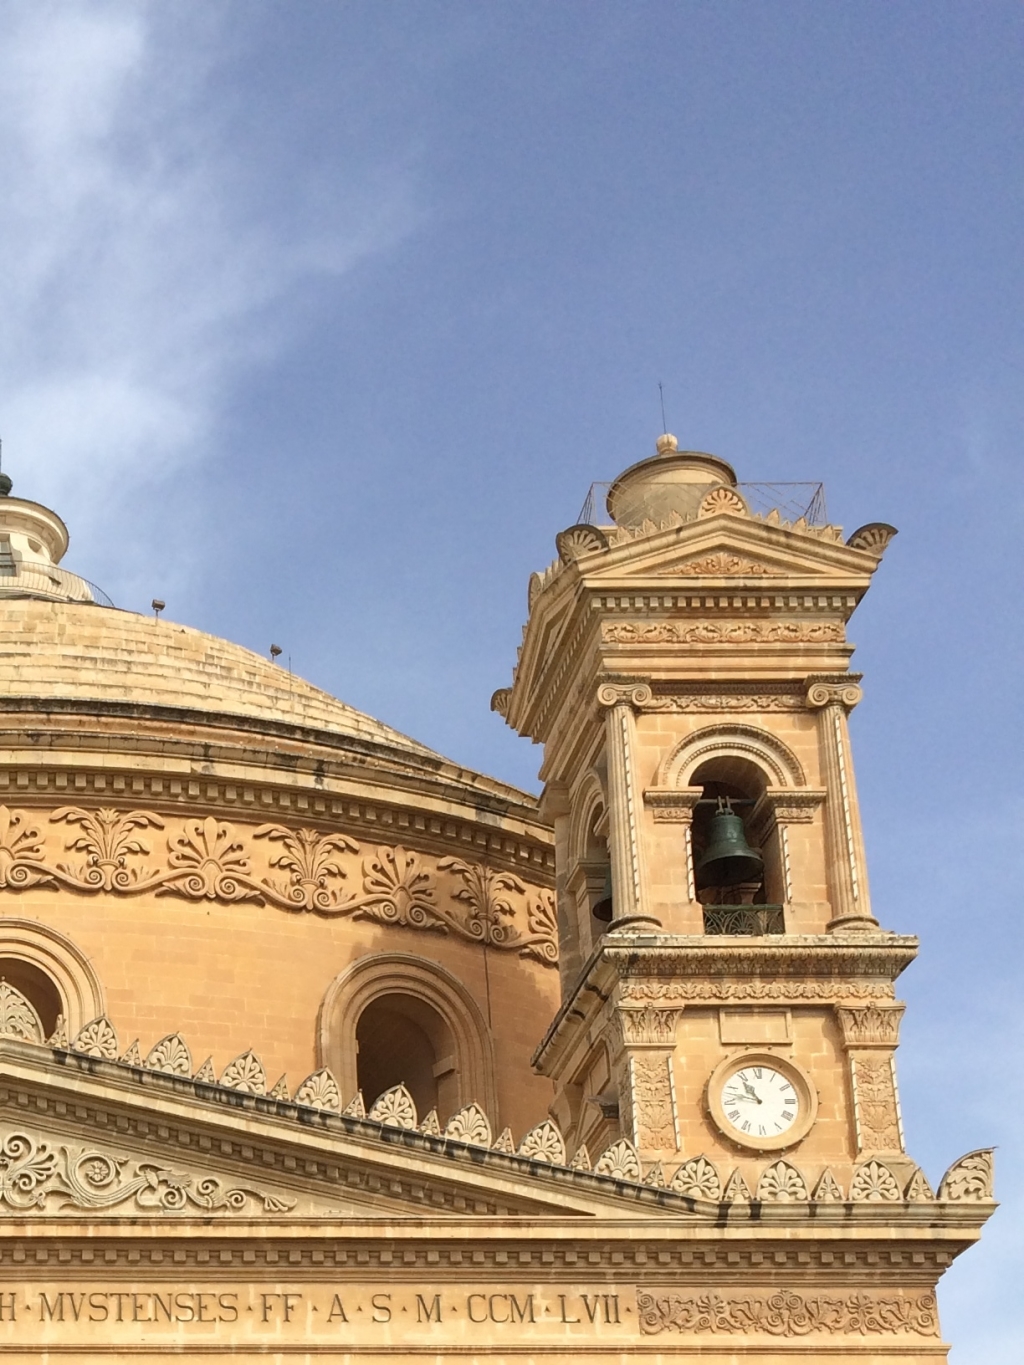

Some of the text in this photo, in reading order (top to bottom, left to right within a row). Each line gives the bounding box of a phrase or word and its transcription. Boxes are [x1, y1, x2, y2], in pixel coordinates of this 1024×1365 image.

[38, 1292, 239, 1323] MVSTENSES
[259, 1292, 303, 1323] FF
[326, 1292, 350, 1323] A
[371, 1292, 392, 1323] S
[415, 1292, 443, 1323] M
[466, 1292, 536, 1323] CCM
[557, 1292, 622, 1323] LVII
